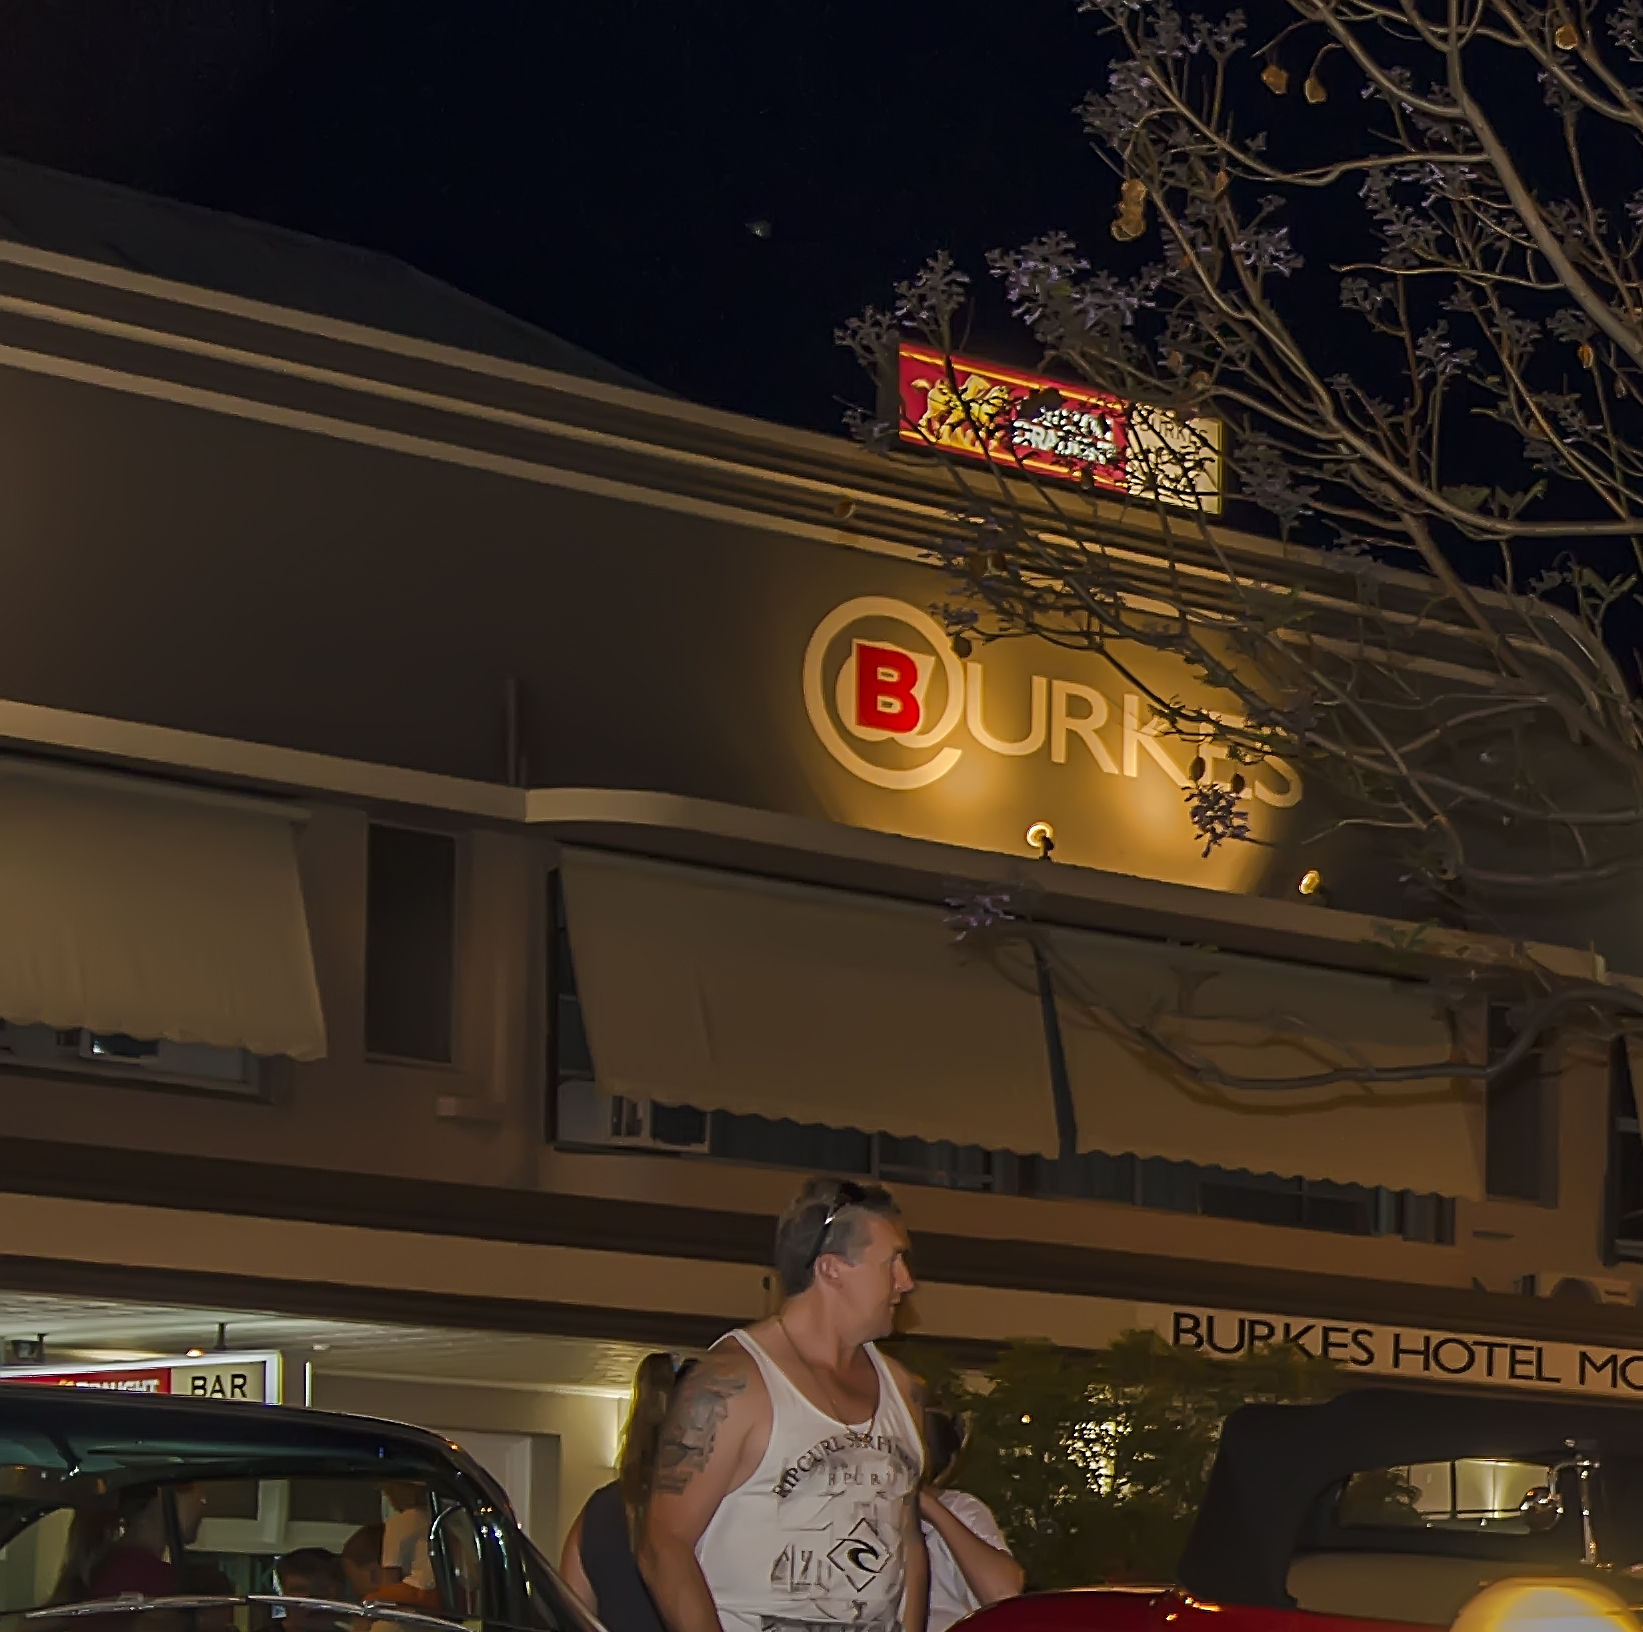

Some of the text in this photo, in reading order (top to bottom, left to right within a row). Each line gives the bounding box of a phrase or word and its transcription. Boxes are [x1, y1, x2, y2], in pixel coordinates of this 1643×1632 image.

[806, 598, 1302, 808] BURKES
[1172, 1311, 1374, 1368] BURKES
[1391, 1333, 1562, 1385] HOTEL
[191, 1373, 247, 1398] BAR
